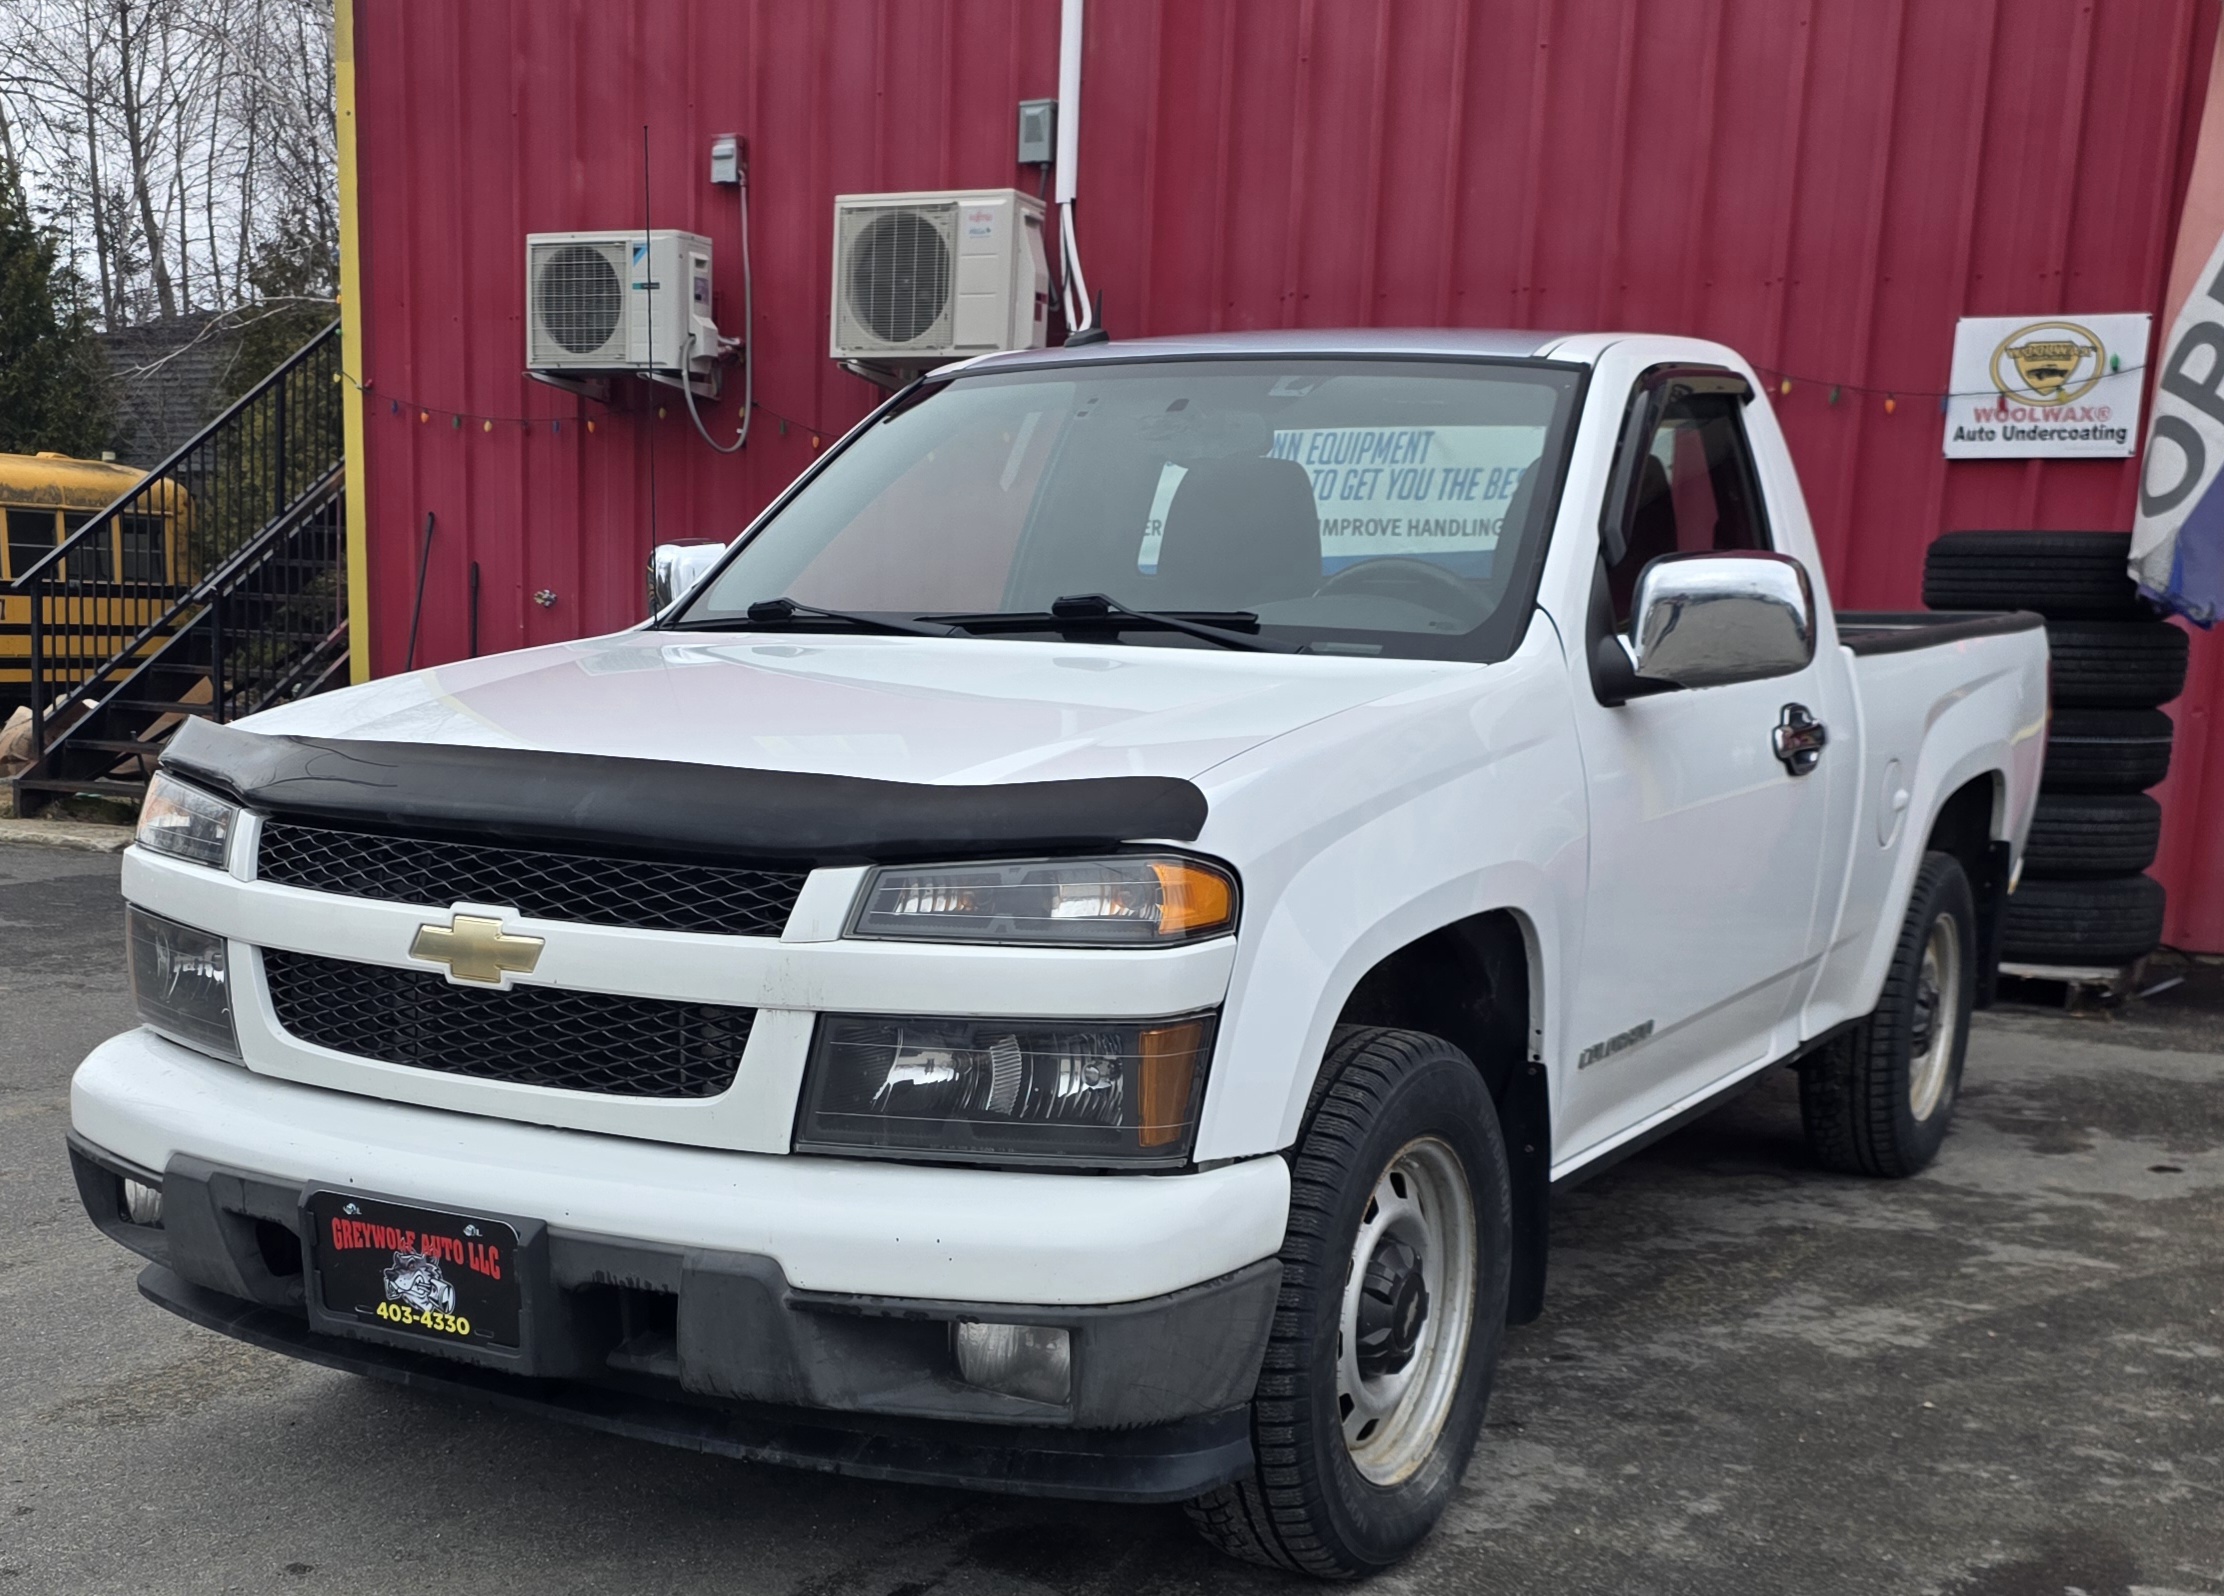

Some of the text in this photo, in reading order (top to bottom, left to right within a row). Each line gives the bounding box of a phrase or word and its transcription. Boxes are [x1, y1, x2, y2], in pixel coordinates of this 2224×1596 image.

[2141, 260, 2224, 518] OP
[1306, 430, 1436, 465] EQUIPMENT
[1953, 424, 2127, 444] Auto Undercoating
[1312, 468, 1339, 500] TO
[1340, 468, 1387, 500] GET
[1389, 467, 1437, 500] YOU
[1439, 467, 1485, 500] THE
[1407, 517, 1504, 537] HANDLING
[331, 1216, 501, 1280] GREYWOLF AUTO LLC
[376, 1301, 470, 1335] 403-4330
